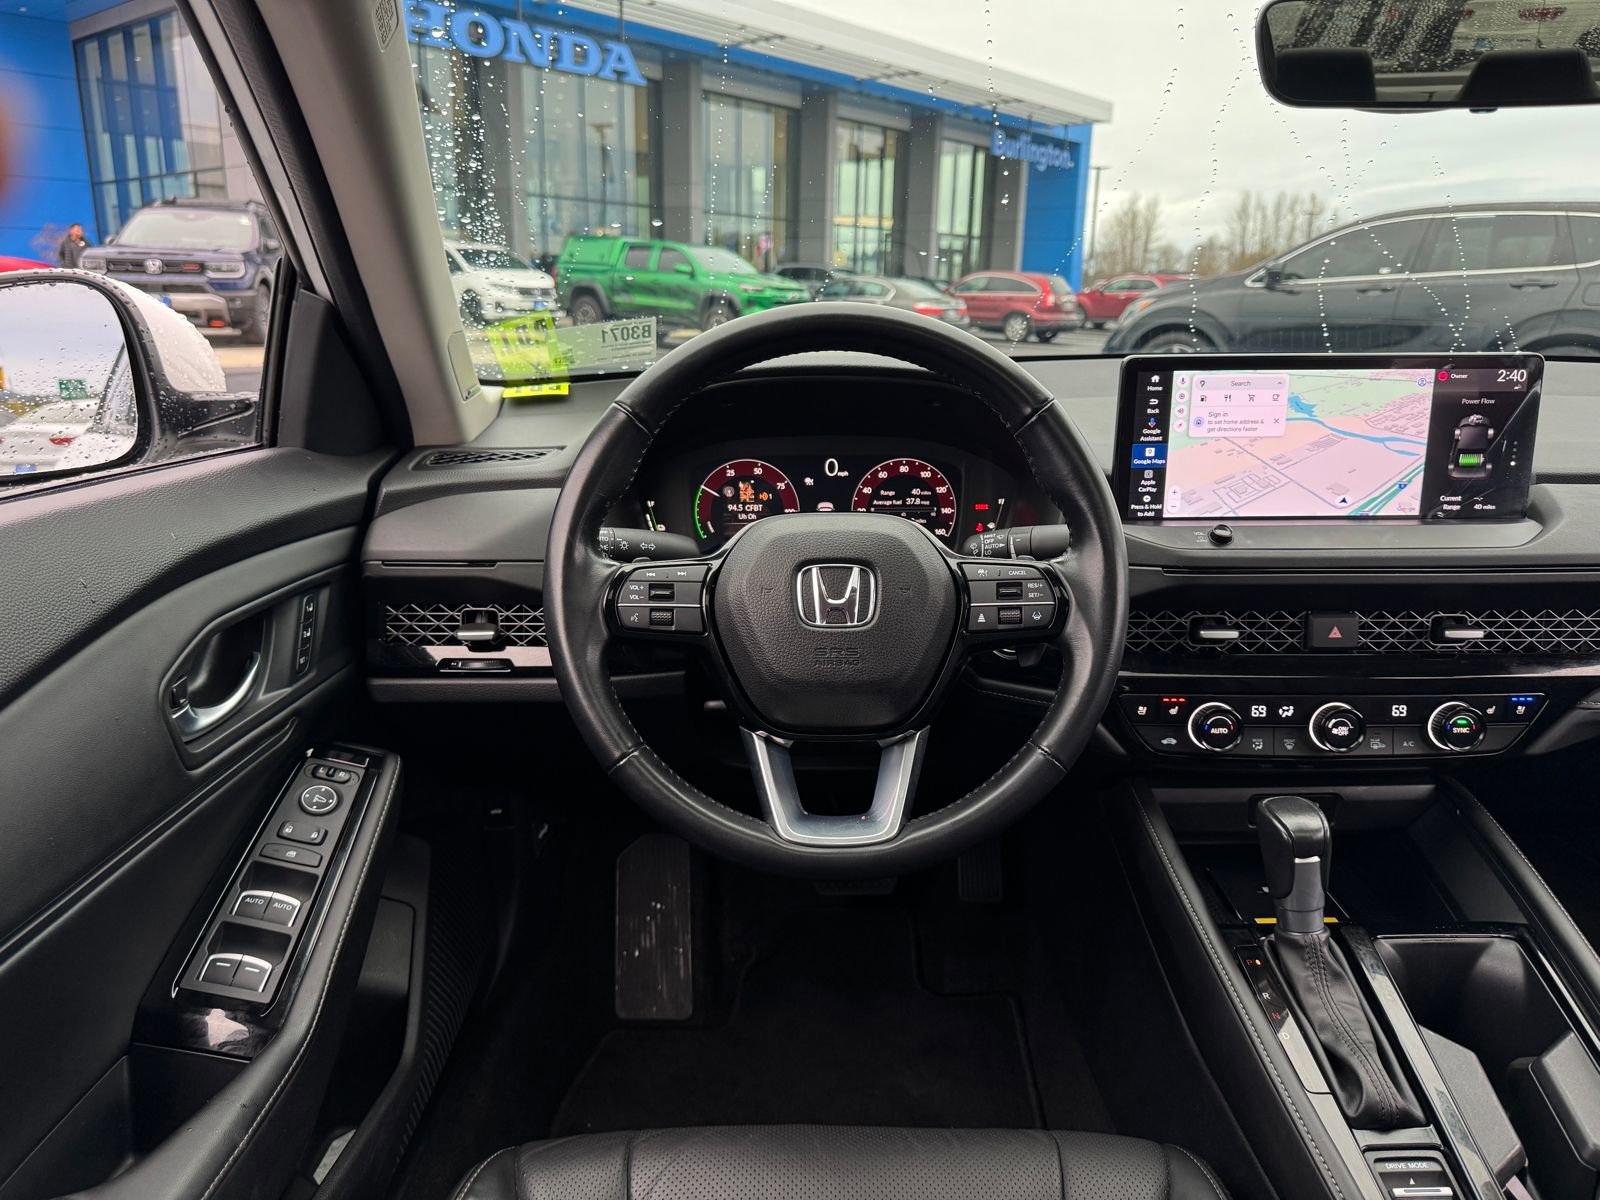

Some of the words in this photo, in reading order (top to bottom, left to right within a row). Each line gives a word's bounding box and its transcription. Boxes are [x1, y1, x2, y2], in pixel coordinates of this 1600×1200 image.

[403, 0, 648, 86] HONDA
[1496, 369, 1527, 382] 2:40
[1208, 411, 1222, 419] Sign
[753, 467, 763, 475] 50
[824, 457, 839, 477] 0
[899, 465, 909, 473] 80
[726, 469, 735, 477] 25
[862, 486, 872, 494] 40
[911, 488, 921, 496] 40
[905, 497, 921, 505] 37.8
[727, 504, 744, 512] 94.5
[745, 504, 764, 512] CFBT
[940, 507, 952, 515] 140
[934, 528, 946, 536] 160
[1250, 705, 1267, 717] 69
[1391, 704, 1408, 717] 69
[244, 897, 265, 905] AUTO
[272, 902, 293, 911] AUTO
[1262, 992, 1271, 1000] R
[1271, 1012, 1281, 1020] N
